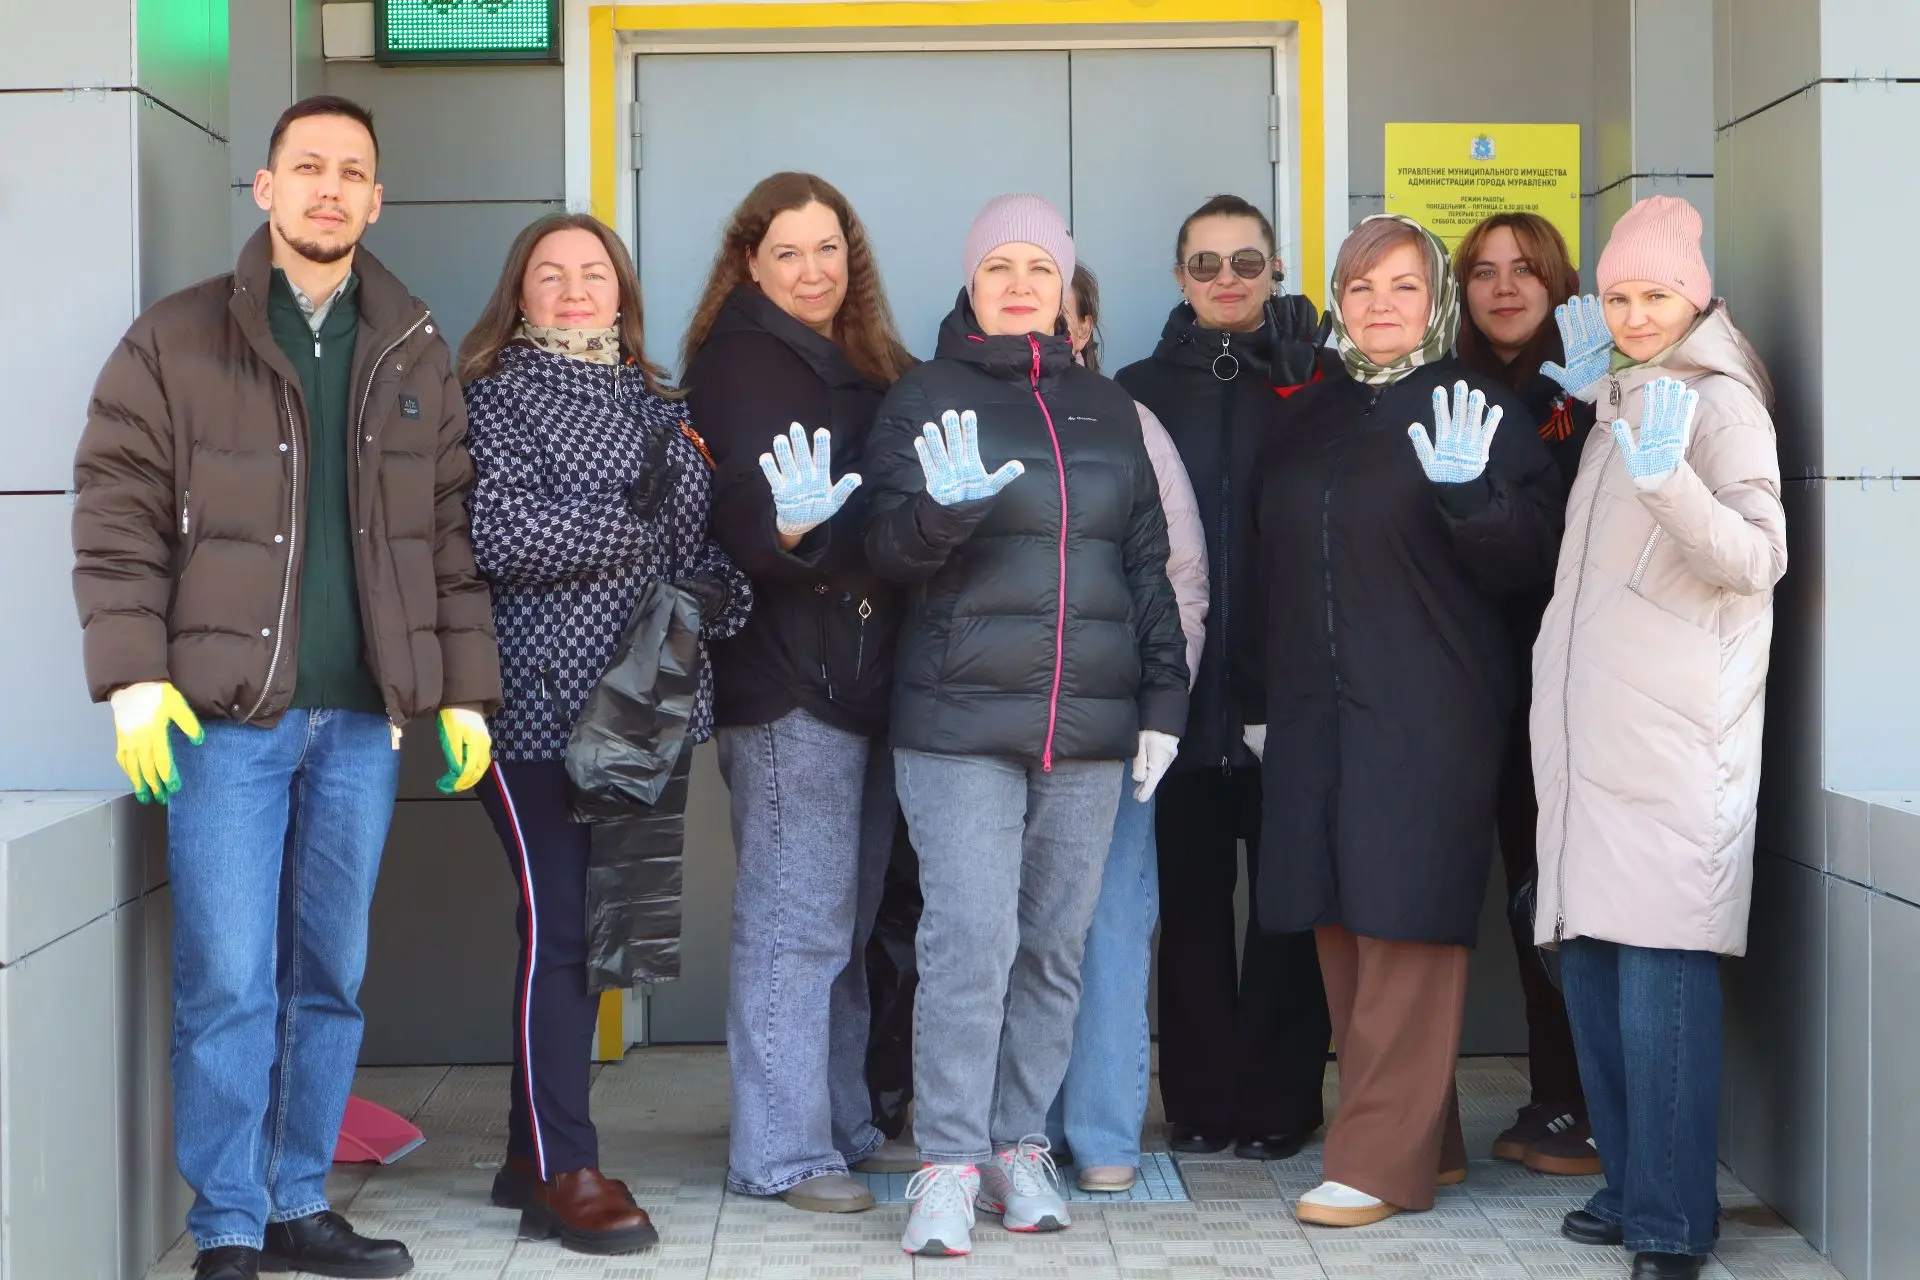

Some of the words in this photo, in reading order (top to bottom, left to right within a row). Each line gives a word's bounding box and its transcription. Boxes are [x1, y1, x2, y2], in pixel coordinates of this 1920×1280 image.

[1397, 167, 1446, 176] УПРАВЛЕНИЕ
[1447, 167, 1519, 177] МУНИЦИПАЛЬНОГО
[1520, 168, 1568, 177] ИМУЩЕСТВА
[1408, 178, 1475, 187] АДМИНИСТРАЦИИ
[1476, 178, 1506, 187] ГОРОДА
[1507, 178, 1557, 187] МУРАВЛЕНКО
